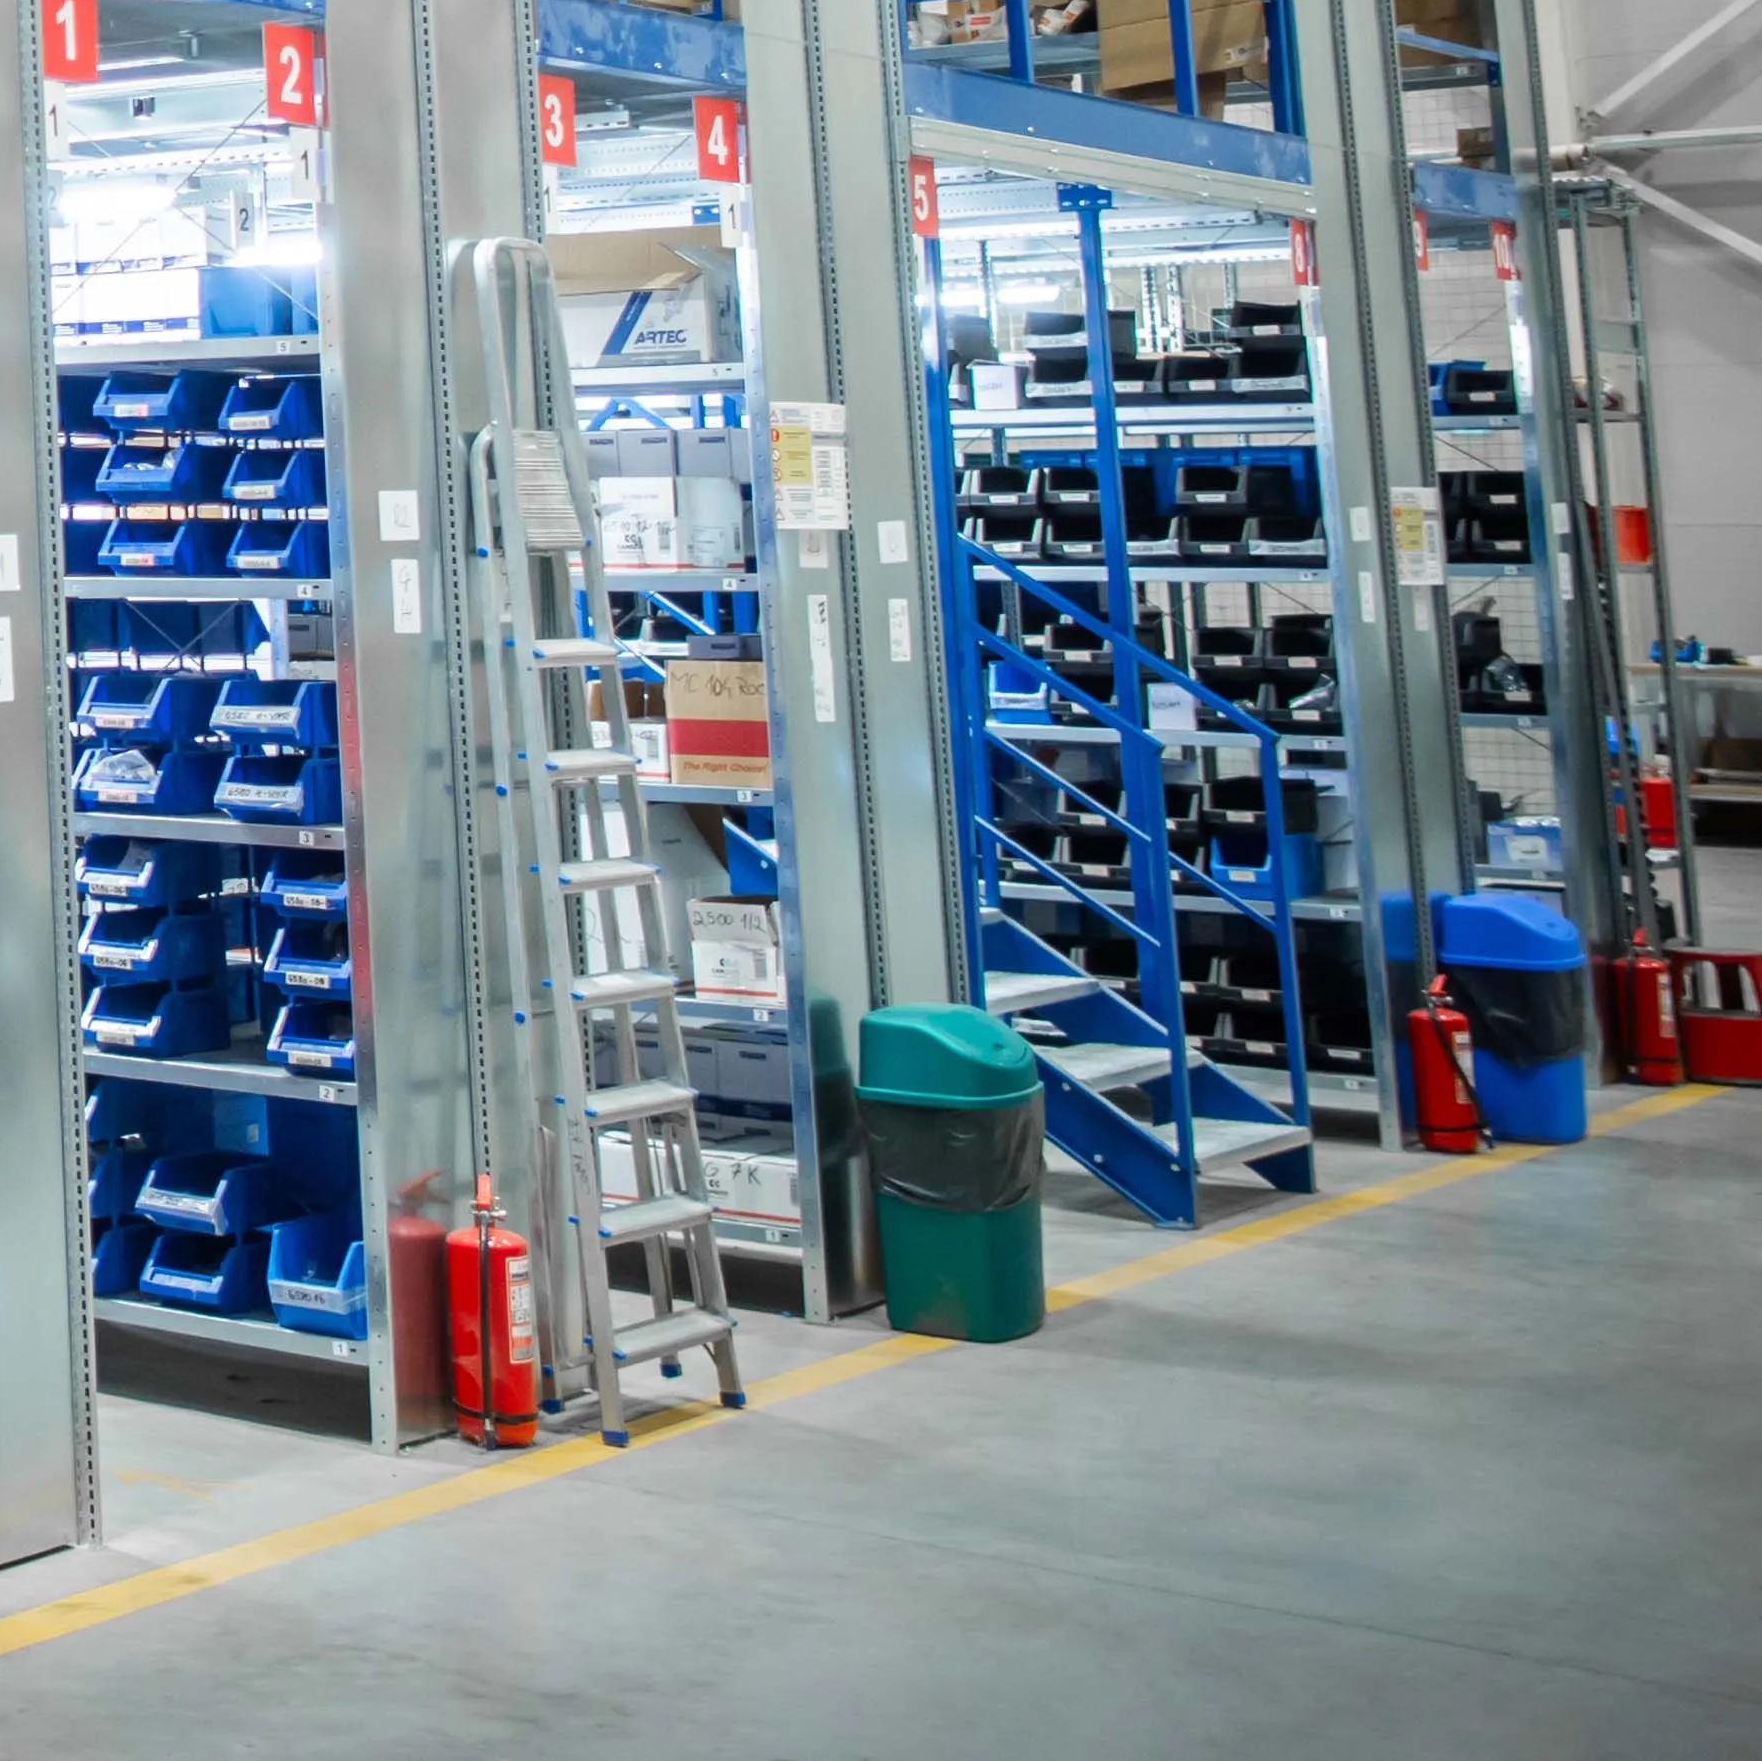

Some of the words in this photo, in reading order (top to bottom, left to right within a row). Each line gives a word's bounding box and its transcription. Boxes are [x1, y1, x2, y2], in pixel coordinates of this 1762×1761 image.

[56, 0, 76, 61] 1
[279, 46, 302, 104] 2
[50, 104, 57, 136] 1
[545, 94, 563, 148] 3
[708, 115, 727, 166] 4
[301, 150, 309, 180] 1
[914, 175, 928, 222] 5
[239, 208, 248, 231] 2
[728, 203, 736, 230] 1
[1295, 233, 1304, 274] 8
[280, 342, 286, 351] 5
[634, 328, 688, 345] ARTEC
[712, 367, 718, 377] 5
[302, 586, 308, 596] 4
[683, 761, 699, 772] The
[702, 761, 727, 774] Right
[729, 761, 767, 773] Choice!
[741, 792, 748, 800] 3
[303, 832, 310, 843] 3
[694, 910, 734, 927] 2500
[758, 1012, 765, 1020] 2
[324, 1088, 330, 1098] 2
